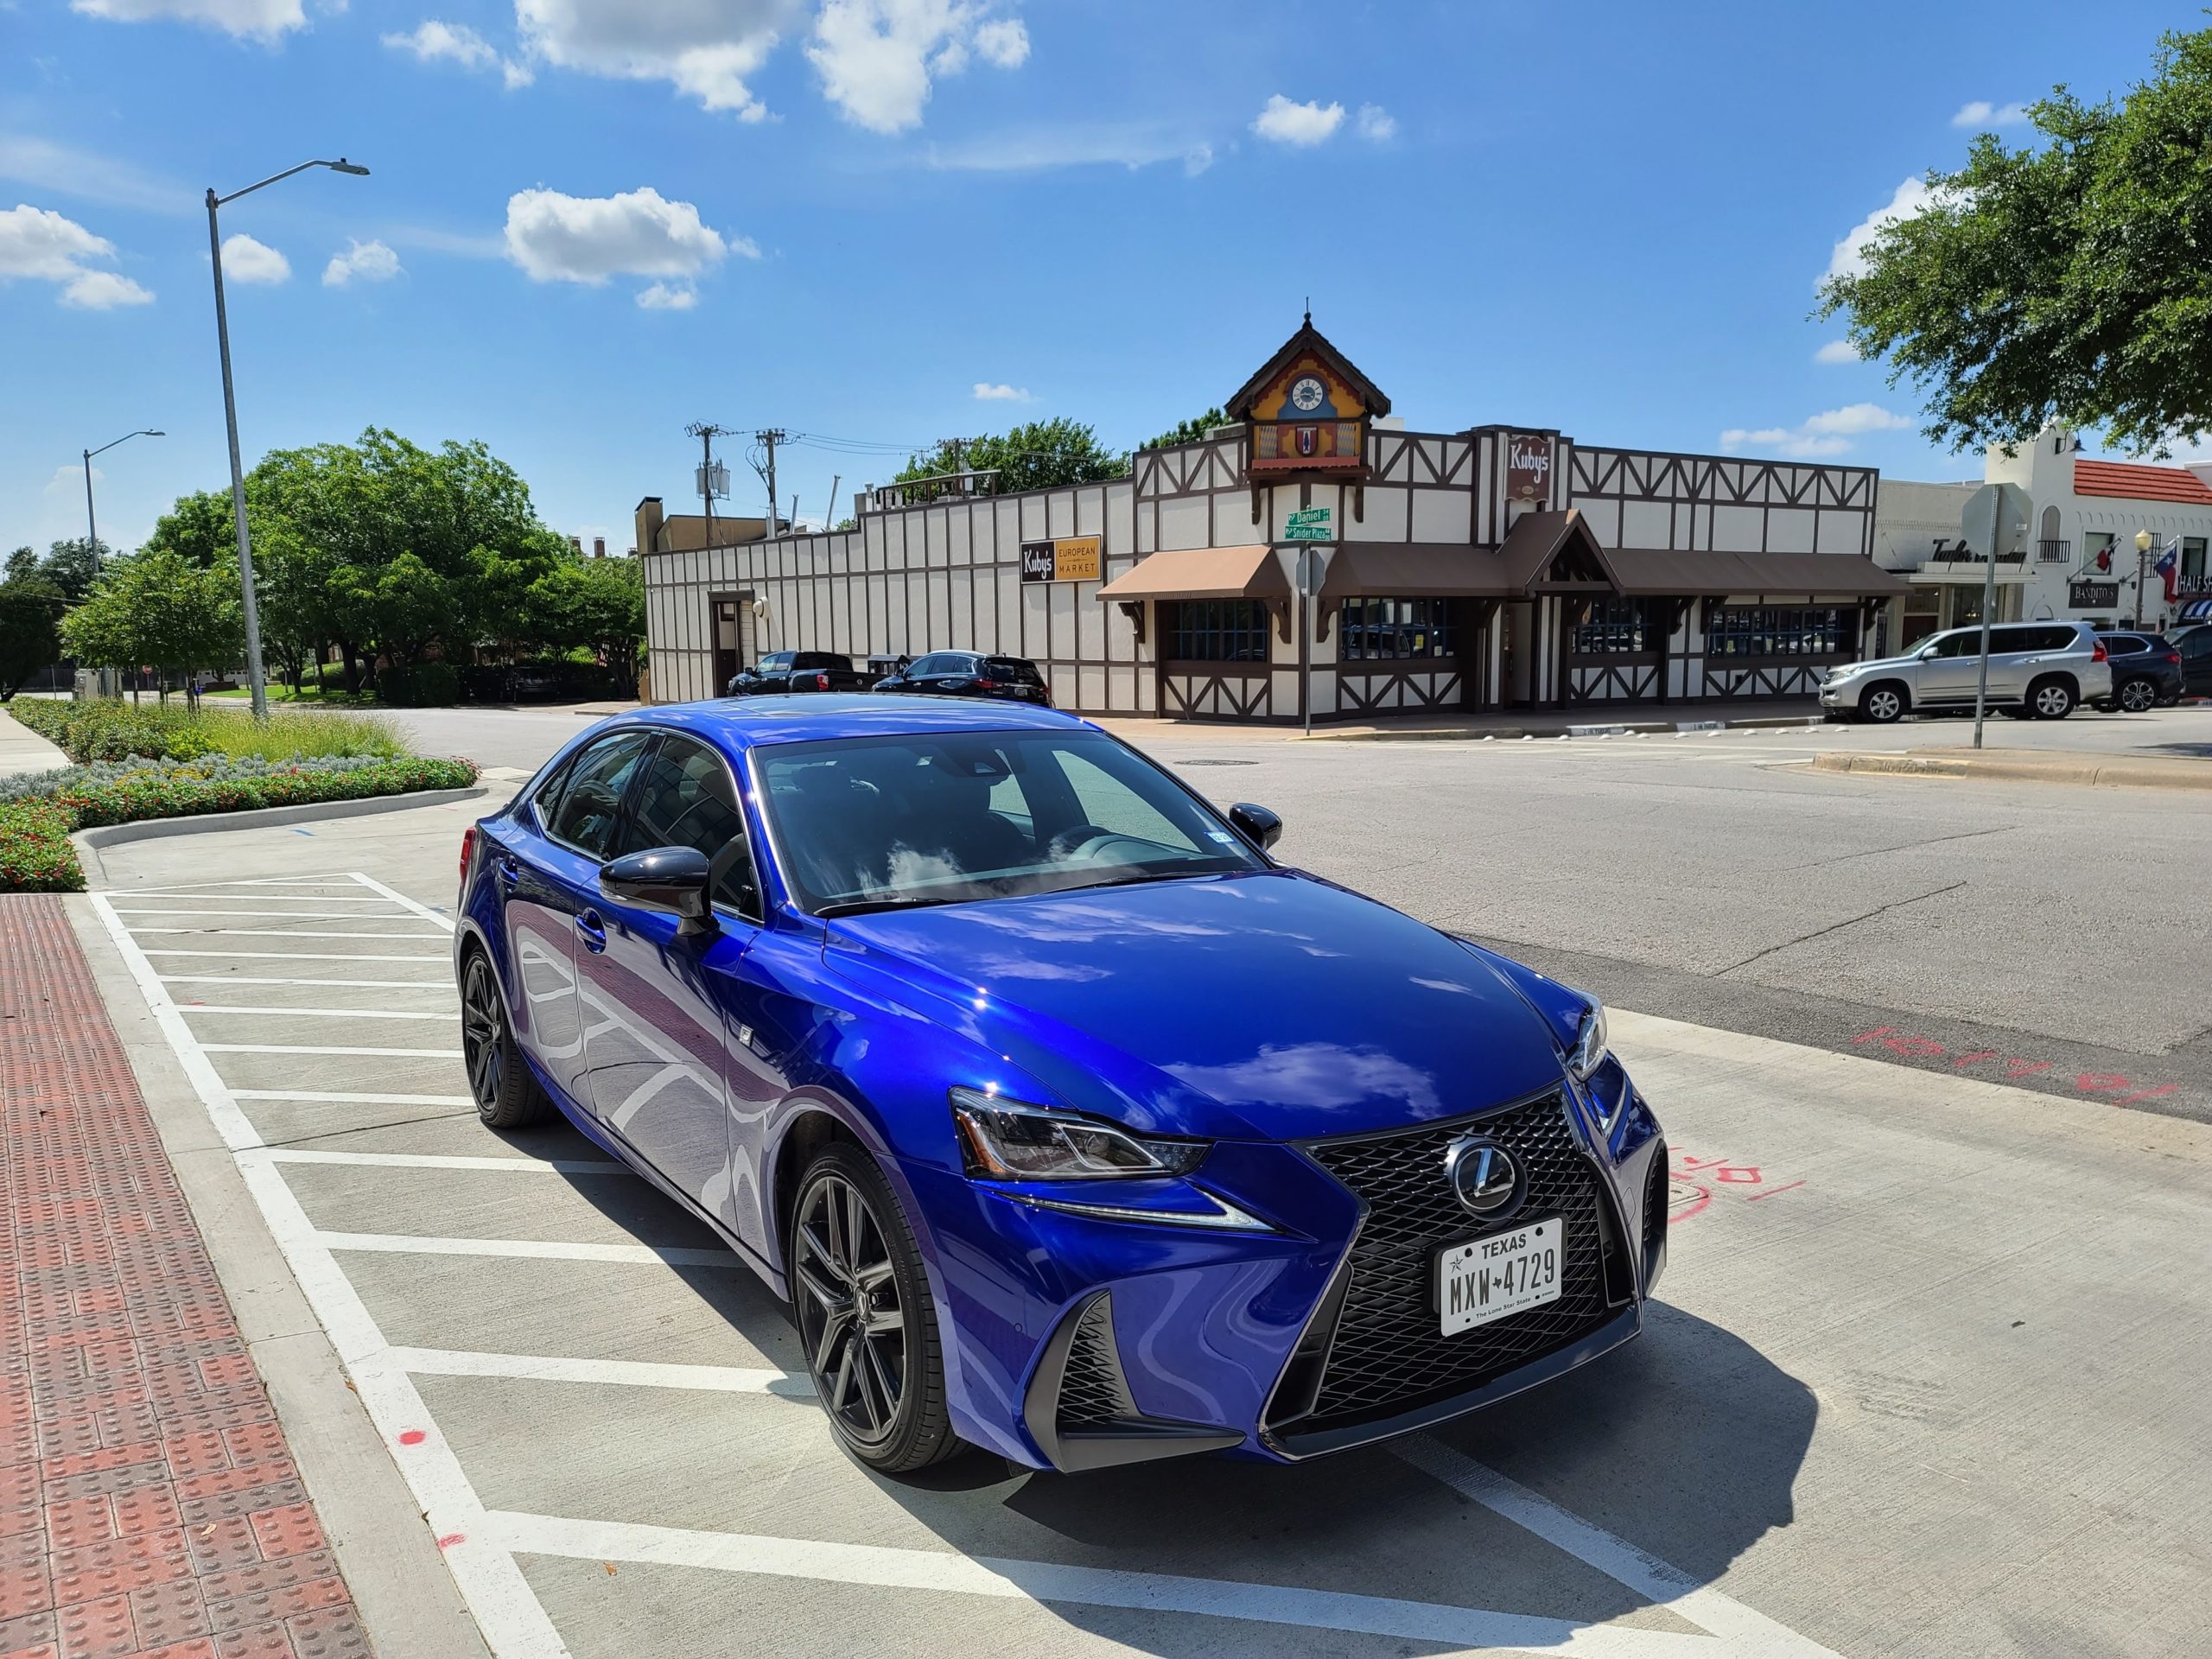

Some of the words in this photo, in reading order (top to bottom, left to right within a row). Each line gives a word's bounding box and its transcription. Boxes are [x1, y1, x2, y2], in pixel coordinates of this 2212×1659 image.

[1510, 442, 1549, 484] Kuby's
[1297, 510, 1320, 523] Daniel
[1294, 527, 1311, 537] Snider
[1312, 528, 1325, 539] Plaza
[1058, 547, 1096, 557] EUROPEAN
[1024, 549, 1052, 580] Kuby's
[1058, 563, 1096, 573] MARKET
[2179, 575, 2201, 592] HALF
[1481, 1233, 1527, 1260] TEXAS
[1503, 1248, 1554, 1297] 4729
[1488, 1306, 1503, 1315] Lone
[1503, 1301, 1515, 1310] Star
[1516, 1297, 1531, 1306] State
